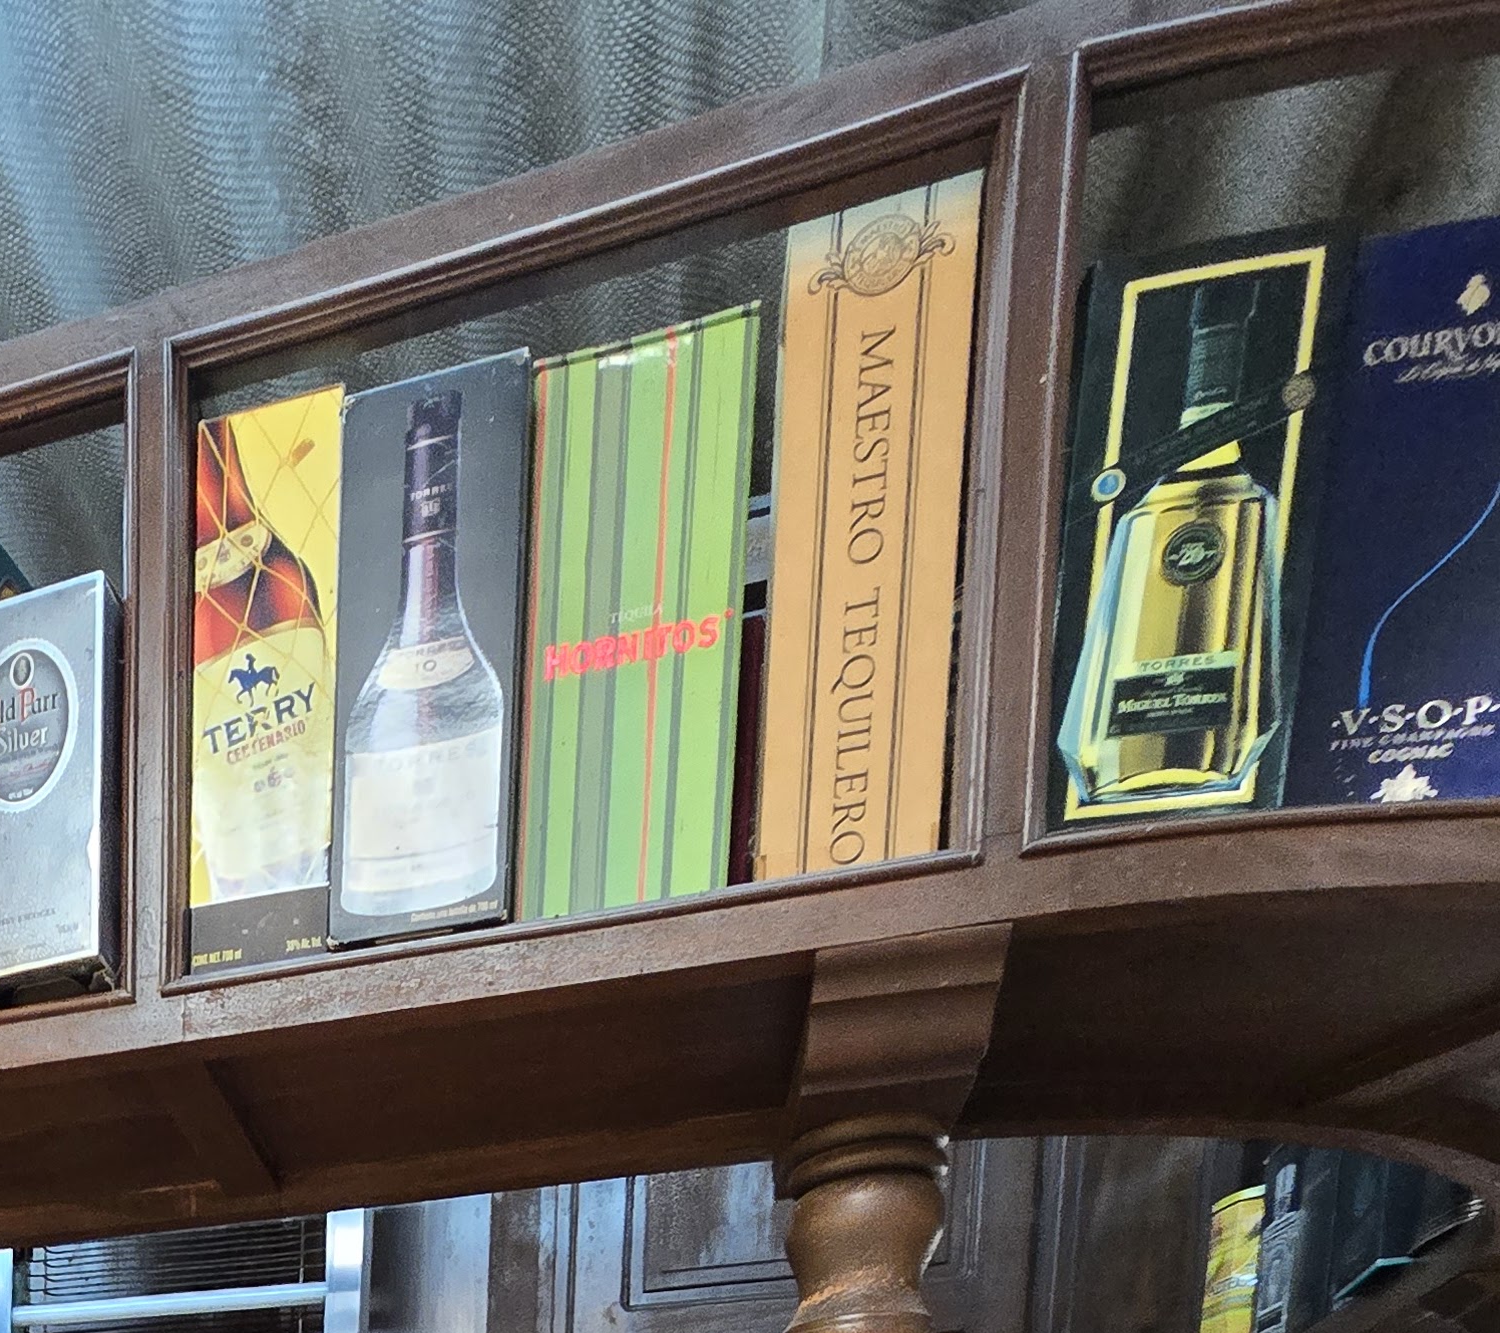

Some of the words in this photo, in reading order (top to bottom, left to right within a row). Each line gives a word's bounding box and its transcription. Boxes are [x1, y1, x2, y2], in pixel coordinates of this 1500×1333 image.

[847, 325, 897, 565] MAESTRO
[544, 614, 721, 682] HORNITOS
[1140, 655, 1215, 672] TORRES
[19, 686, 58, 726] Parr
[202, 682, 316, 754] TERRY
[829, 585, 881, 866] TEQUILERO
[1367, 742, 1455, 764] COGNAC
